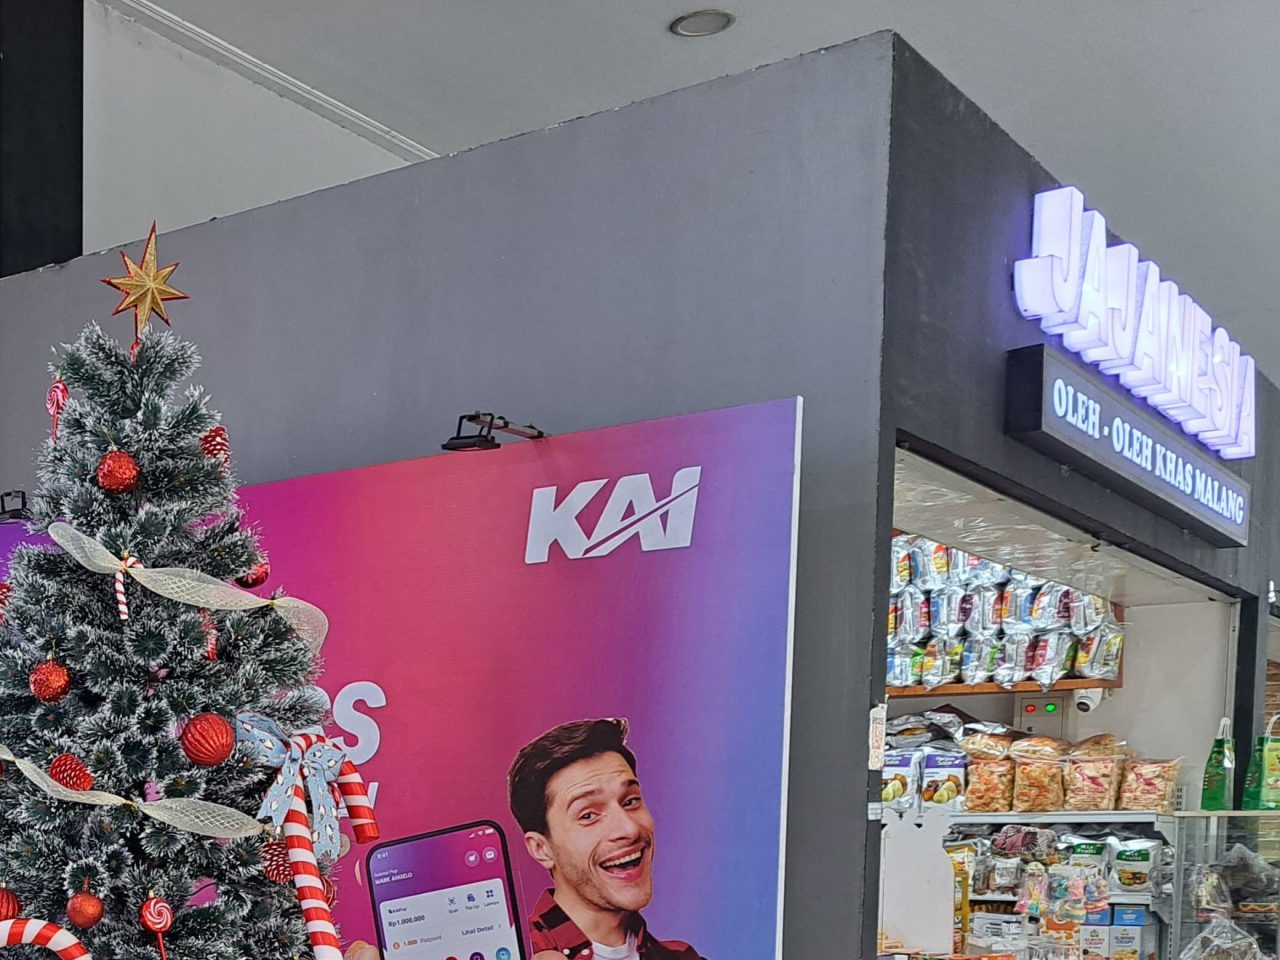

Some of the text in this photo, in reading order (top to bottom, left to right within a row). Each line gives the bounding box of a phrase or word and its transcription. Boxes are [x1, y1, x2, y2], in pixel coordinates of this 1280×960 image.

[1014, 186, 1256, 459] JAJANESIA
[1053, 378, 1244, 525] OLEH OLEH KHAS MALANG
[525, 465, 702, 564] KAI
[375, 872, 413, 885] MARK ANGELO
[476, 924, 494, 934] Detail
